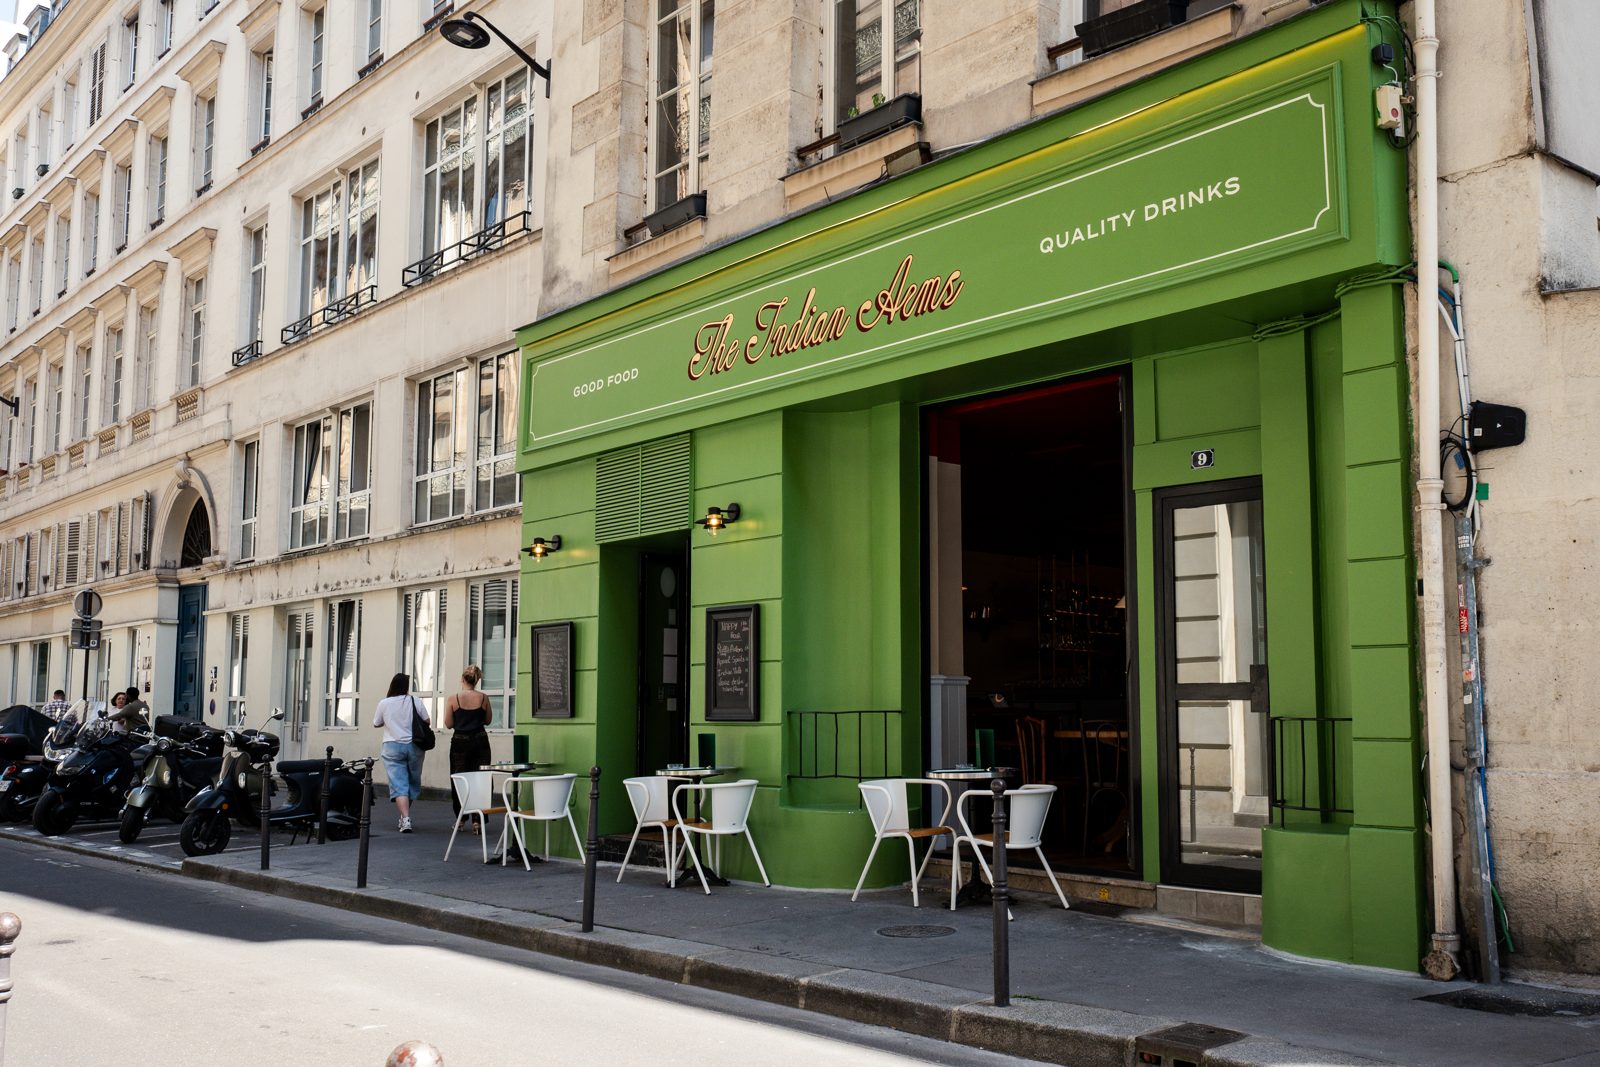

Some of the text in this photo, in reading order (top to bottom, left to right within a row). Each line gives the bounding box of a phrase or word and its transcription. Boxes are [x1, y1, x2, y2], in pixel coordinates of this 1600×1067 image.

[1039, 176, 1241, 254] QUALITY DRINKS
[687, 313, 740, 380] The
[744, 287, 851, 364] Indian
[573, 367, 639, 398] GOOD FOOD
[1197, 452, 1208, 466] 9
